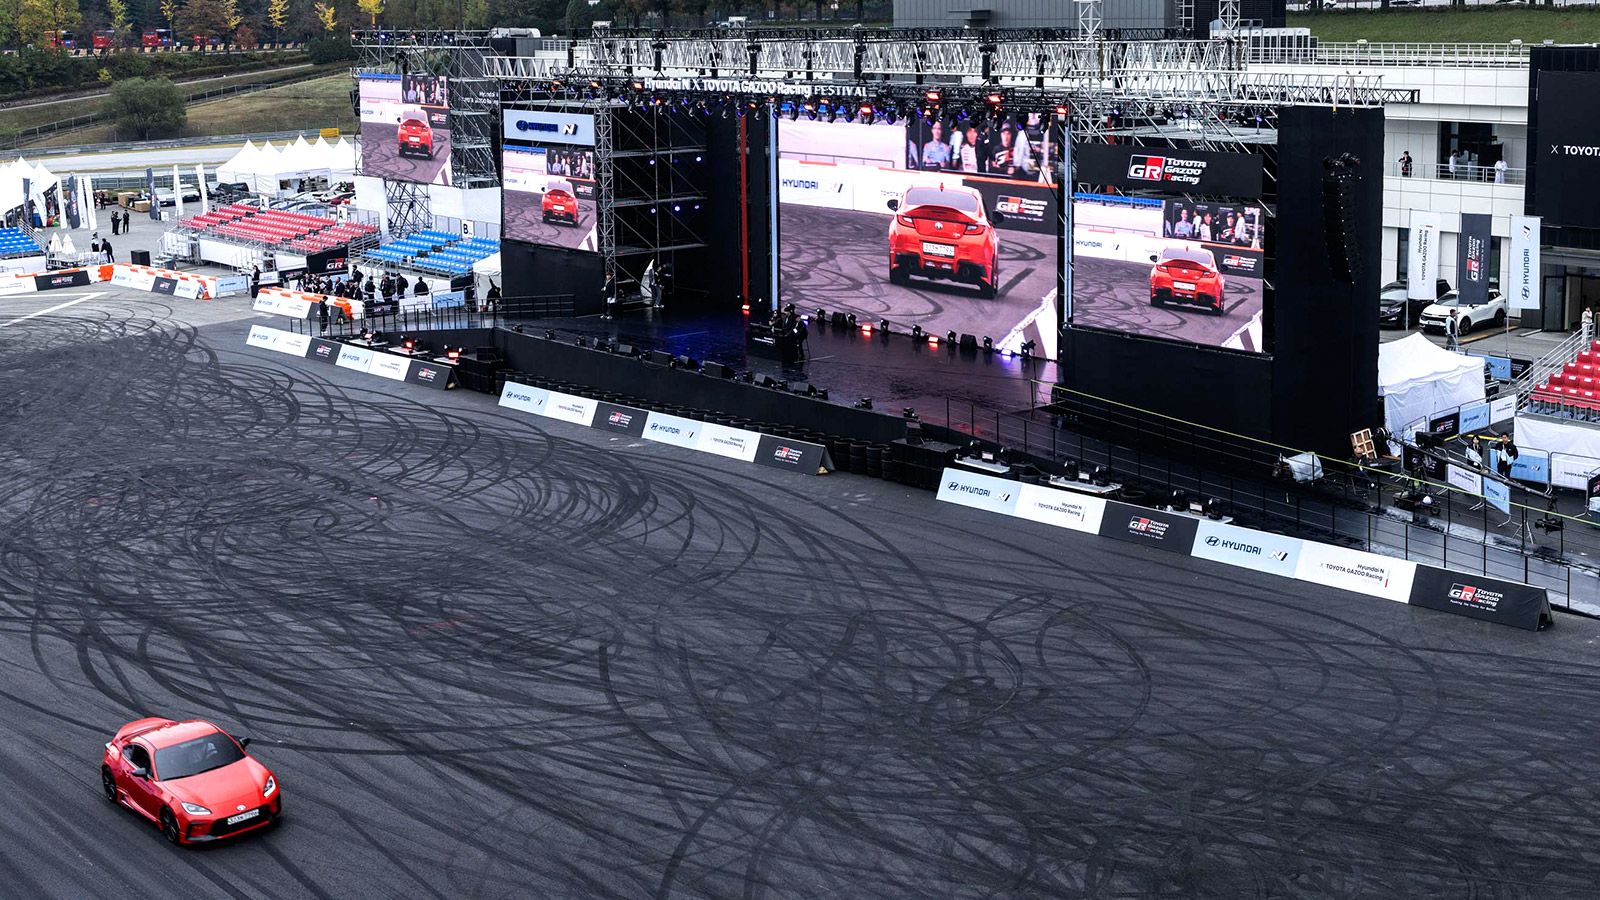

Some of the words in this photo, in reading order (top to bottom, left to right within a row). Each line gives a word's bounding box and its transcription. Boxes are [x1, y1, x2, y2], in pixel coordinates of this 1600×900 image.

[645, 77, 680, 91] Hyundai
[683, 79, 690, 90] N
[693, 79, 700, 91] X
[702, 80, 740, 92] TOYOTA
[741, 81, 776, 94] GAZOO
[778, 82, 812, 98] Racing
[815, 85, 867, 96] FESTIVAL
[1551, 145, 1558, 154] X
[1563, 145, 1600, 156] TOYOT
[1166, 158, 1207, 168] TOYOTA
[1130, 165, 1160, 179] GR
[1164, 166, 1202, 175] GAZOO
[782, 179, 818, 189] HYUNDAI
[1163, 173, 1200, 185] Racing
[339, 210, 343, 219] A
[463, 223, 468, 234] B
[960, 485, 991, 497] HYUNDAI
[1221, 540, 1262, 555] HYUNDAI
[1326, 563, 1346, 572] TOYOTA
[1347, 568, 1365, 576] GAZOO
[1365, 572, 1383, 581] Racing
[1358, 563, 1380, 573] Hyundai
[1450, 589, 1472, 601] GR
[1474, 593, 1500, 602] GAZOO
[1476, 589, 1503, 598] TOYOTA
[1473, 597, 1497, 607] Racing
